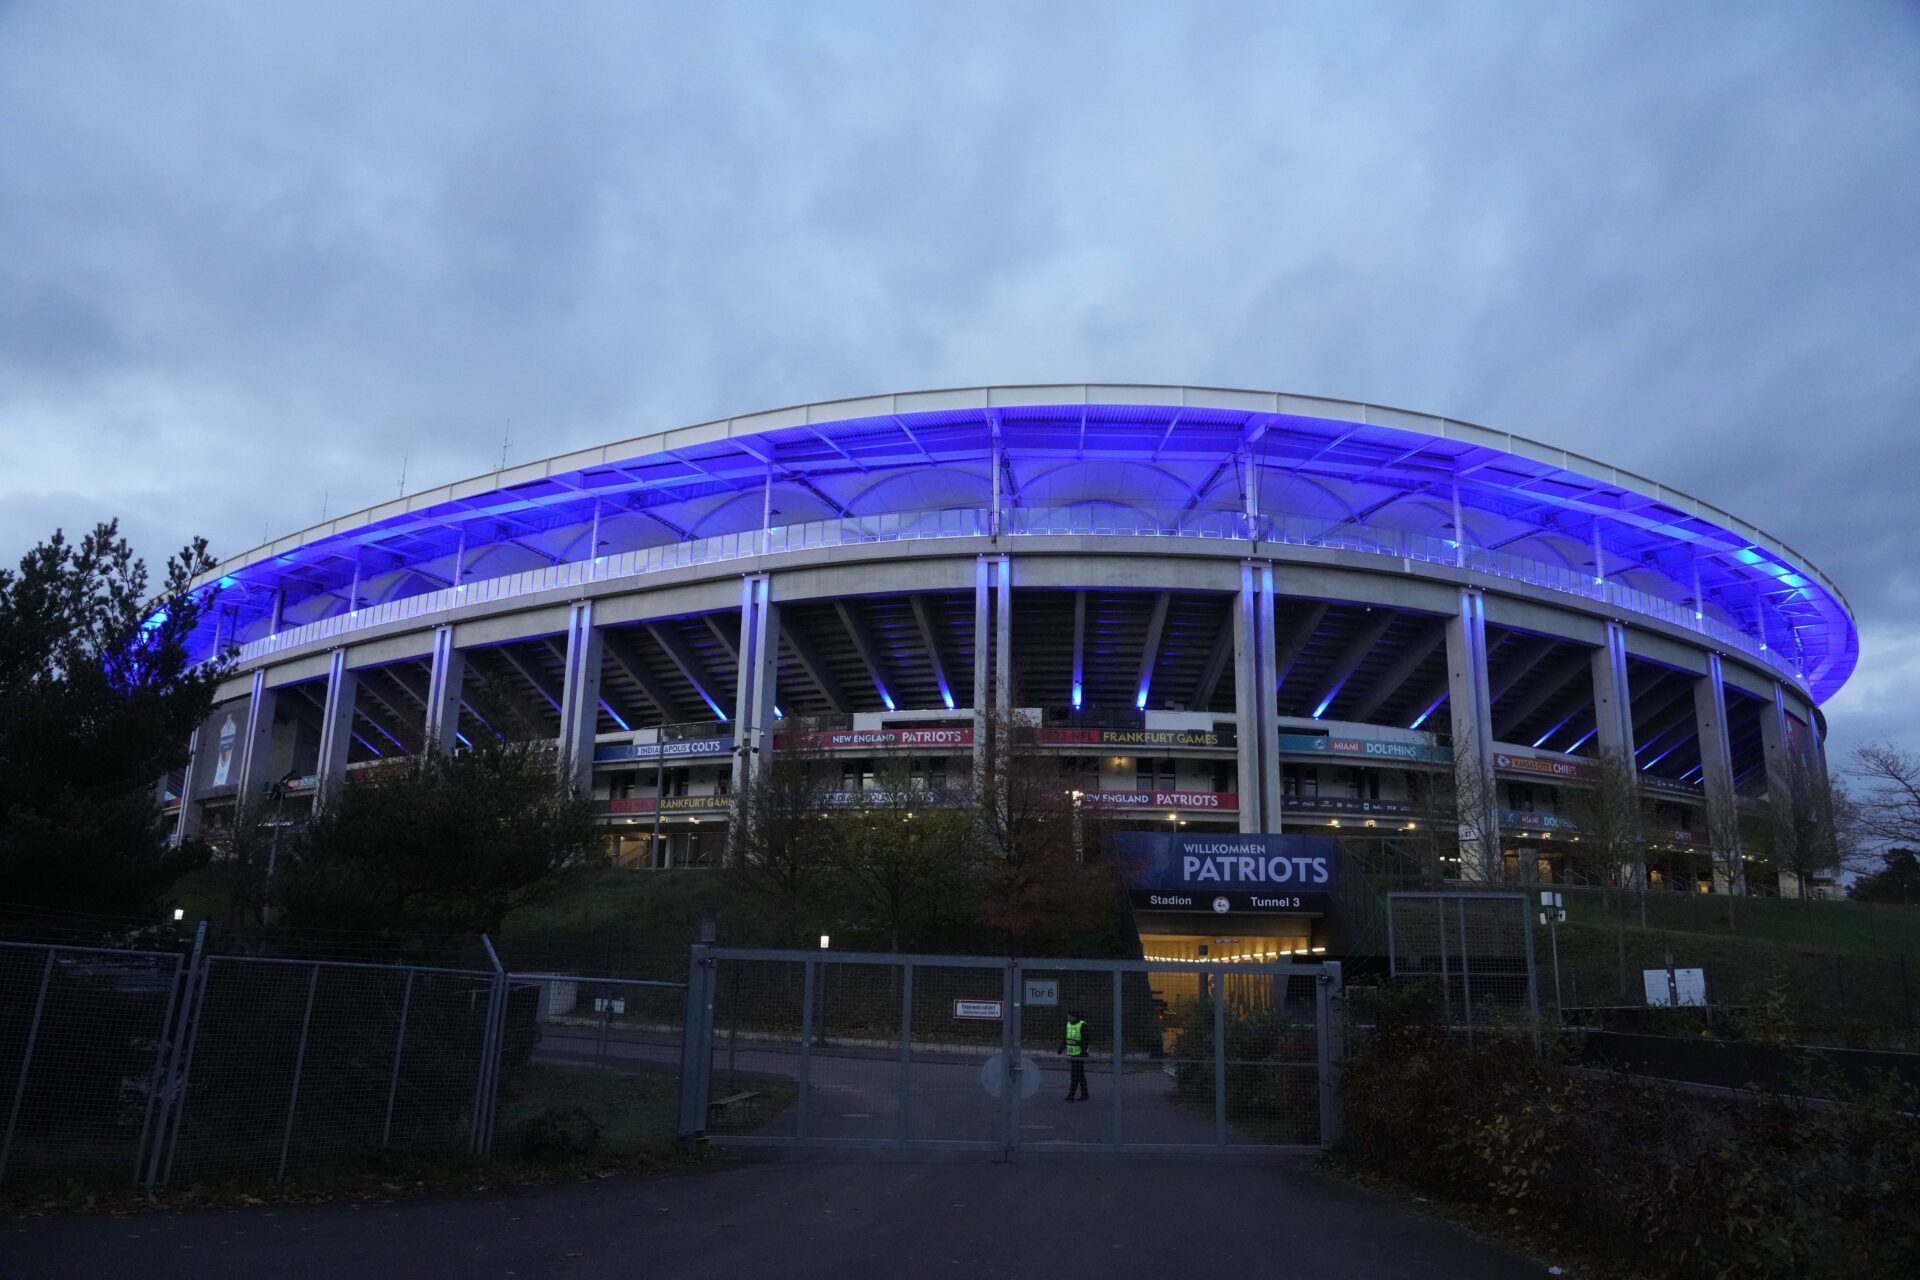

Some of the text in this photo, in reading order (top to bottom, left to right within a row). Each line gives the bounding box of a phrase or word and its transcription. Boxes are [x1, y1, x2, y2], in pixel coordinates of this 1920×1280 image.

[832, 731, 961, 743] NEW ENGLAND PATRIOTS
[1103, 732, 1174, 743] FRANKFURT
[1177, 733, 1218, 745] GAMES
[641, 741, 720, 754] INDIAAPOLIS COLTS
[1334, 742, 1416, 757] MIAMI DOLPHINS
[1537, 761, 1551, 771] CITY
[1553, 764, 1577, 776] CHIEFS
[1103, 794, 1149, 803] ENGLAND
[1157, 794, 1218, 806] PATRIOTS
[1184, 844, 1266, 854] WILLKOMMEN
[1183, 856, 1329, 883] PATRIOTS
[1150, 895, 1301, 908] Stadion Tunnel 3
[1030, 988, 1054, 998] Tor 6
